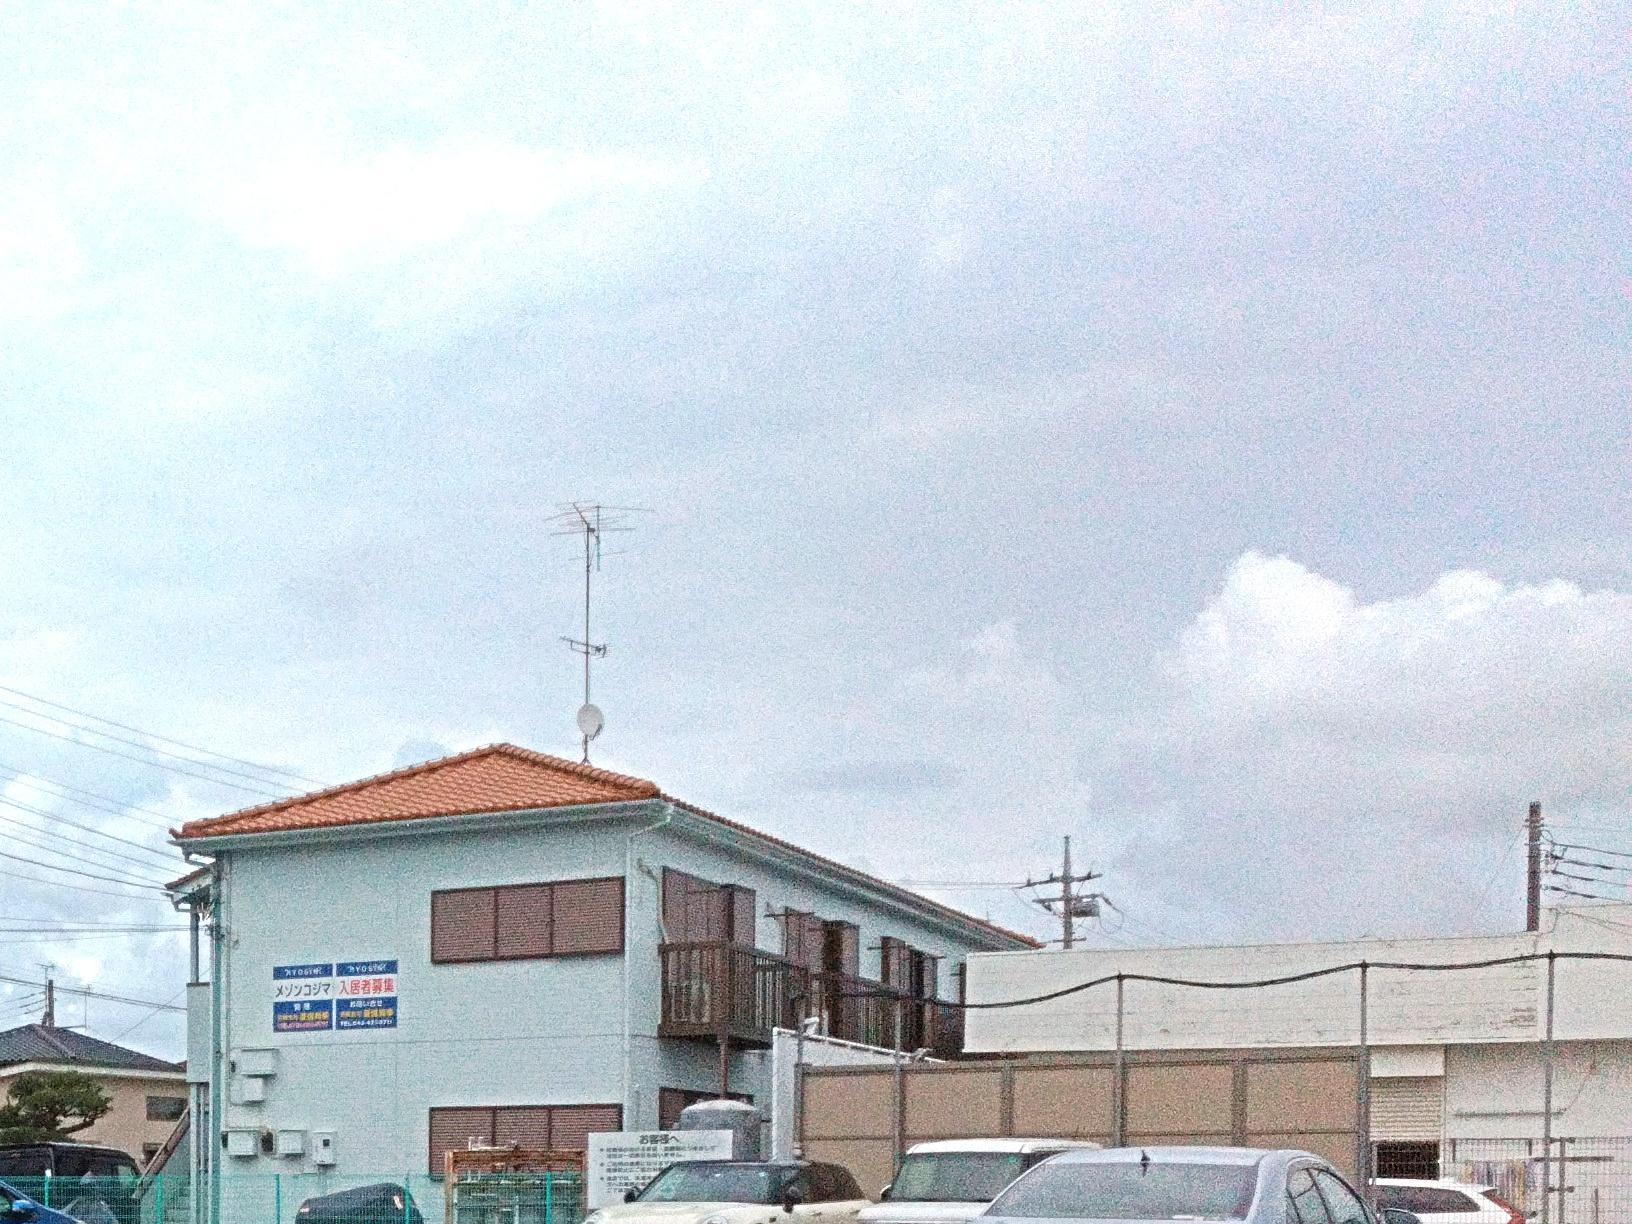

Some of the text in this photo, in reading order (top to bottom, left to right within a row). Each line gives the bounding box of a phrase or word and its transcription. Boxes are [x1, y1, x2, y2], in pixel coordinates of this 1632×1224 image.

[339, 977, 394, 995] 入居者募集
